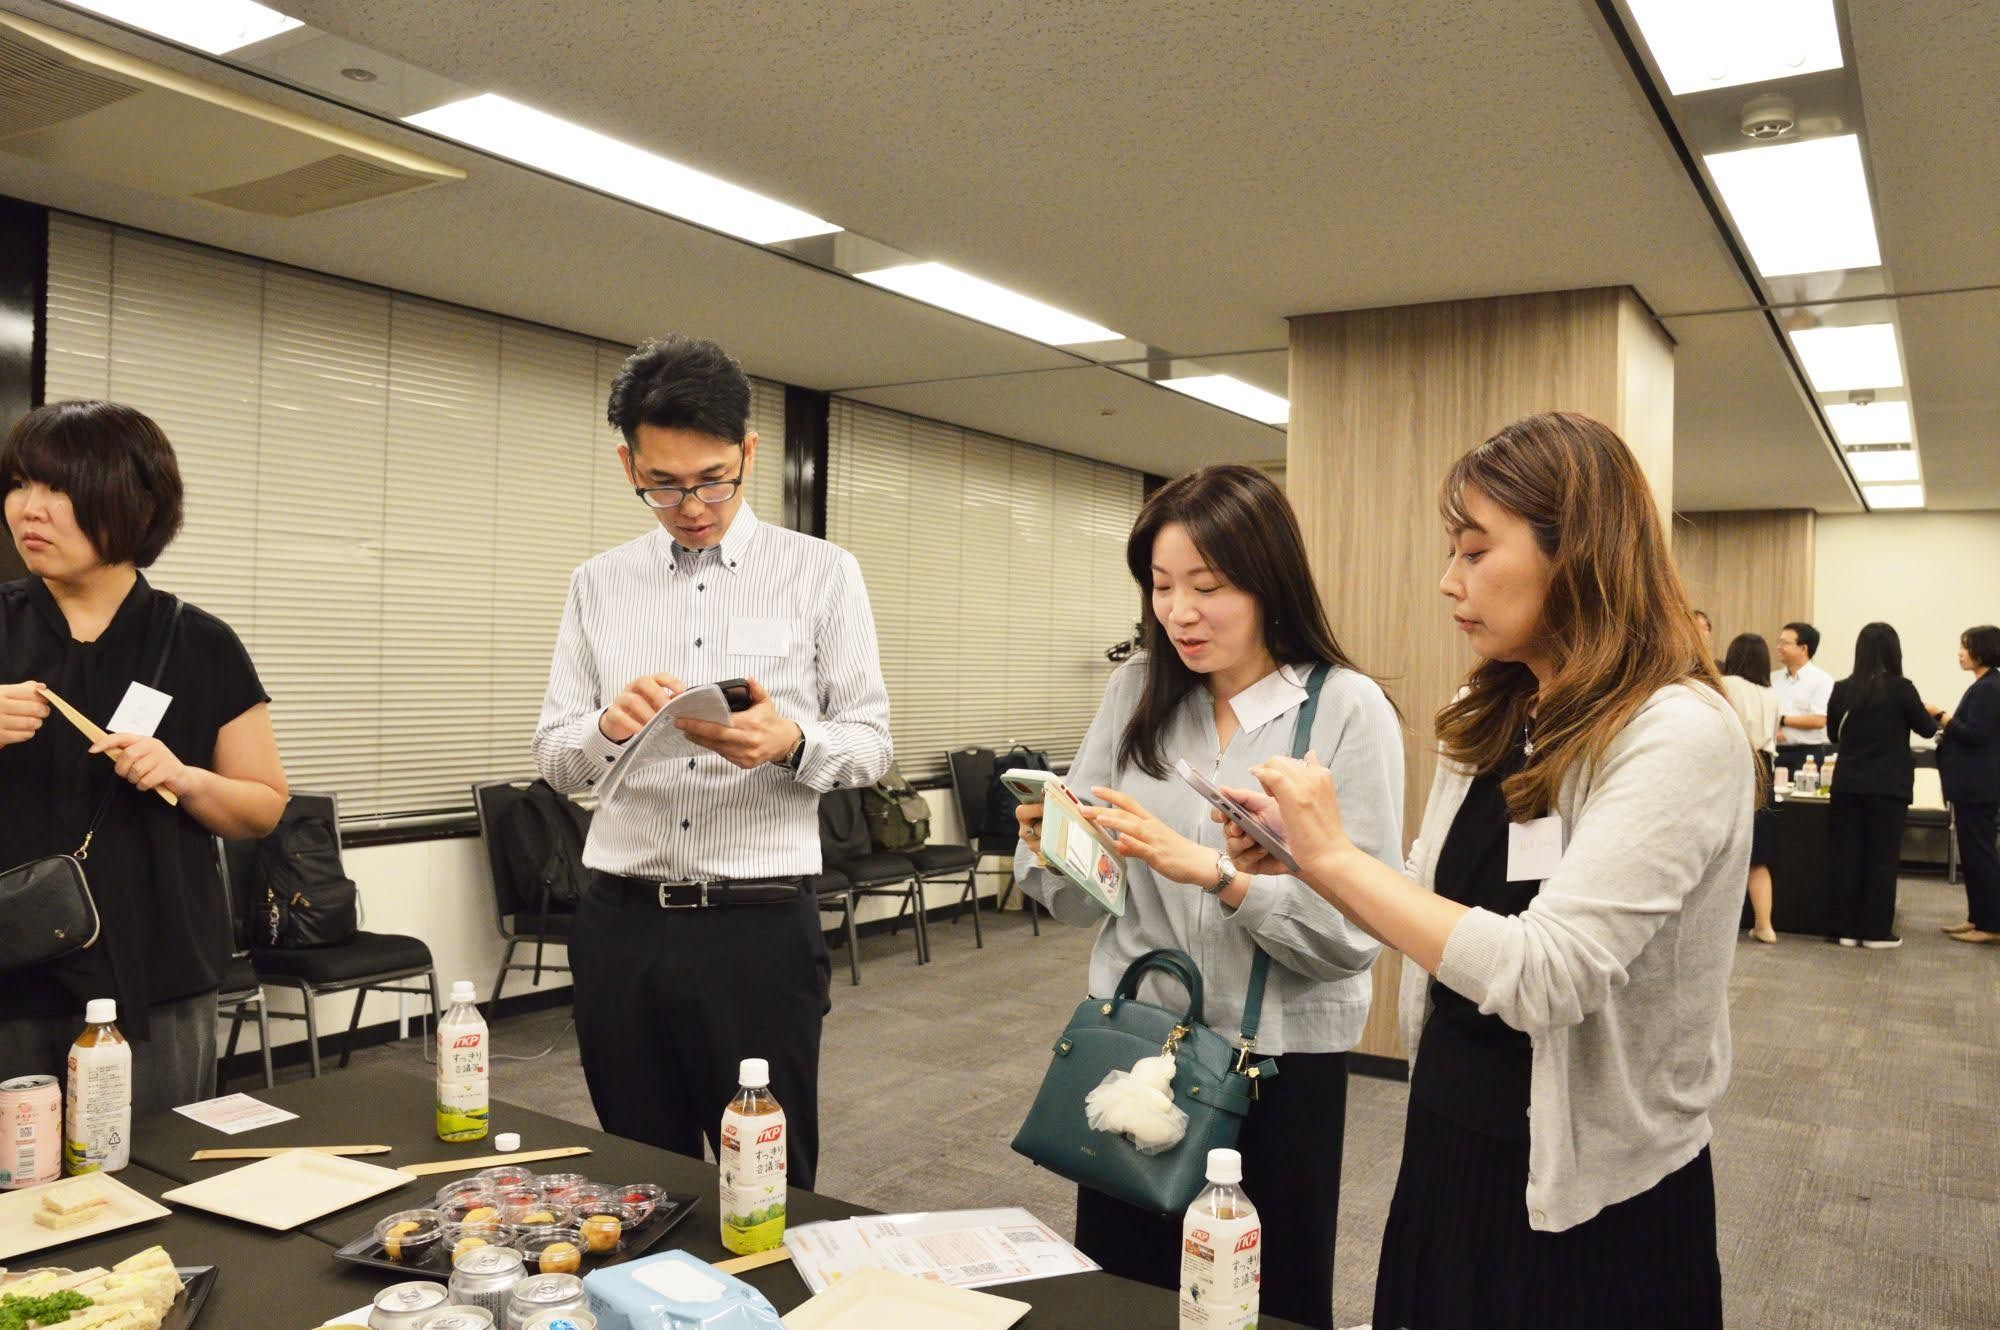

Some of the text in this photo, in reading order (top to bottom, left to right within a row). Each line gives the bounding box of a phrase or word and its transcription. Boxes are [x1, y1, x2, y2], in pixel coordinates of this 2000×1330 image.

[453, 1034, 480, 1048] TKP
[757, 1125, 782, 1144] TKP
[1192, 1229, 1210, 1243] TKP
[1234, 1228, 1259, 1253] TKP
